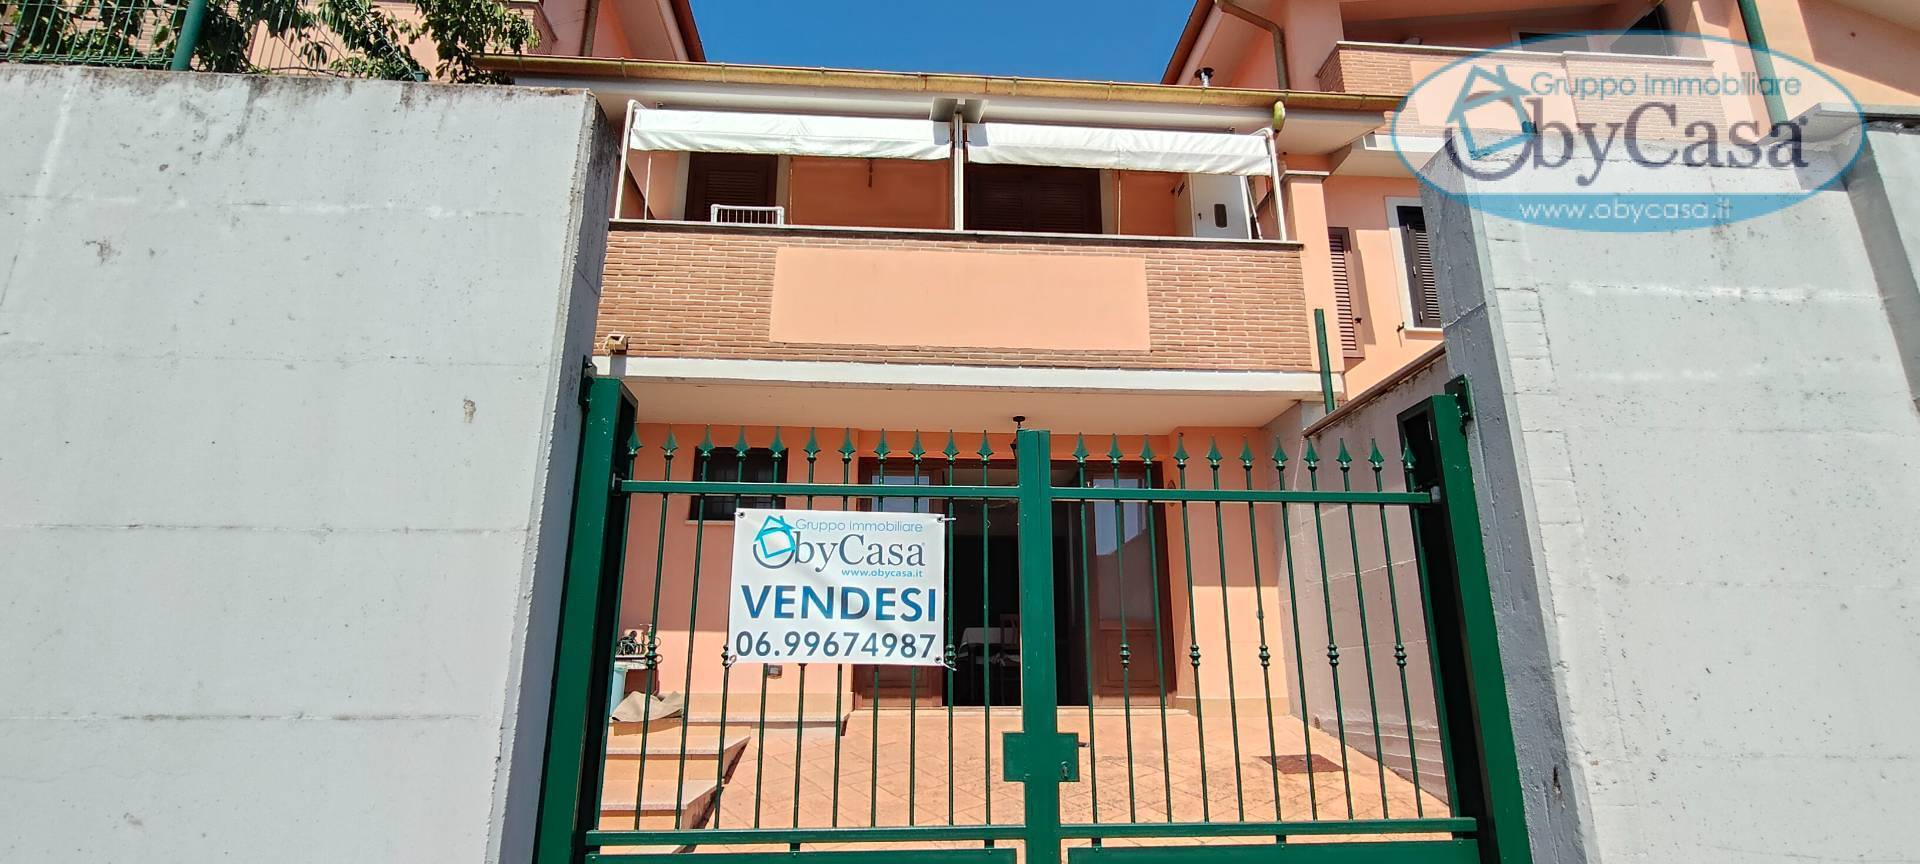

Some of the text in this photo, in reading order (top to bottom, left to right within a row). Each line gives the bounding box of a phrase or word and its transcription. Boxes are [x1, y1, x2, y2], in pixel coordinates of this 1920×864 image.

[795, 518, 923, 533] Gruppo Immobiliare
[841, 568, 924, 578] www.obycasa.it
[741, 584, 936, 622] VENDESI
[735, 630, 937, 659] 06.99674987
